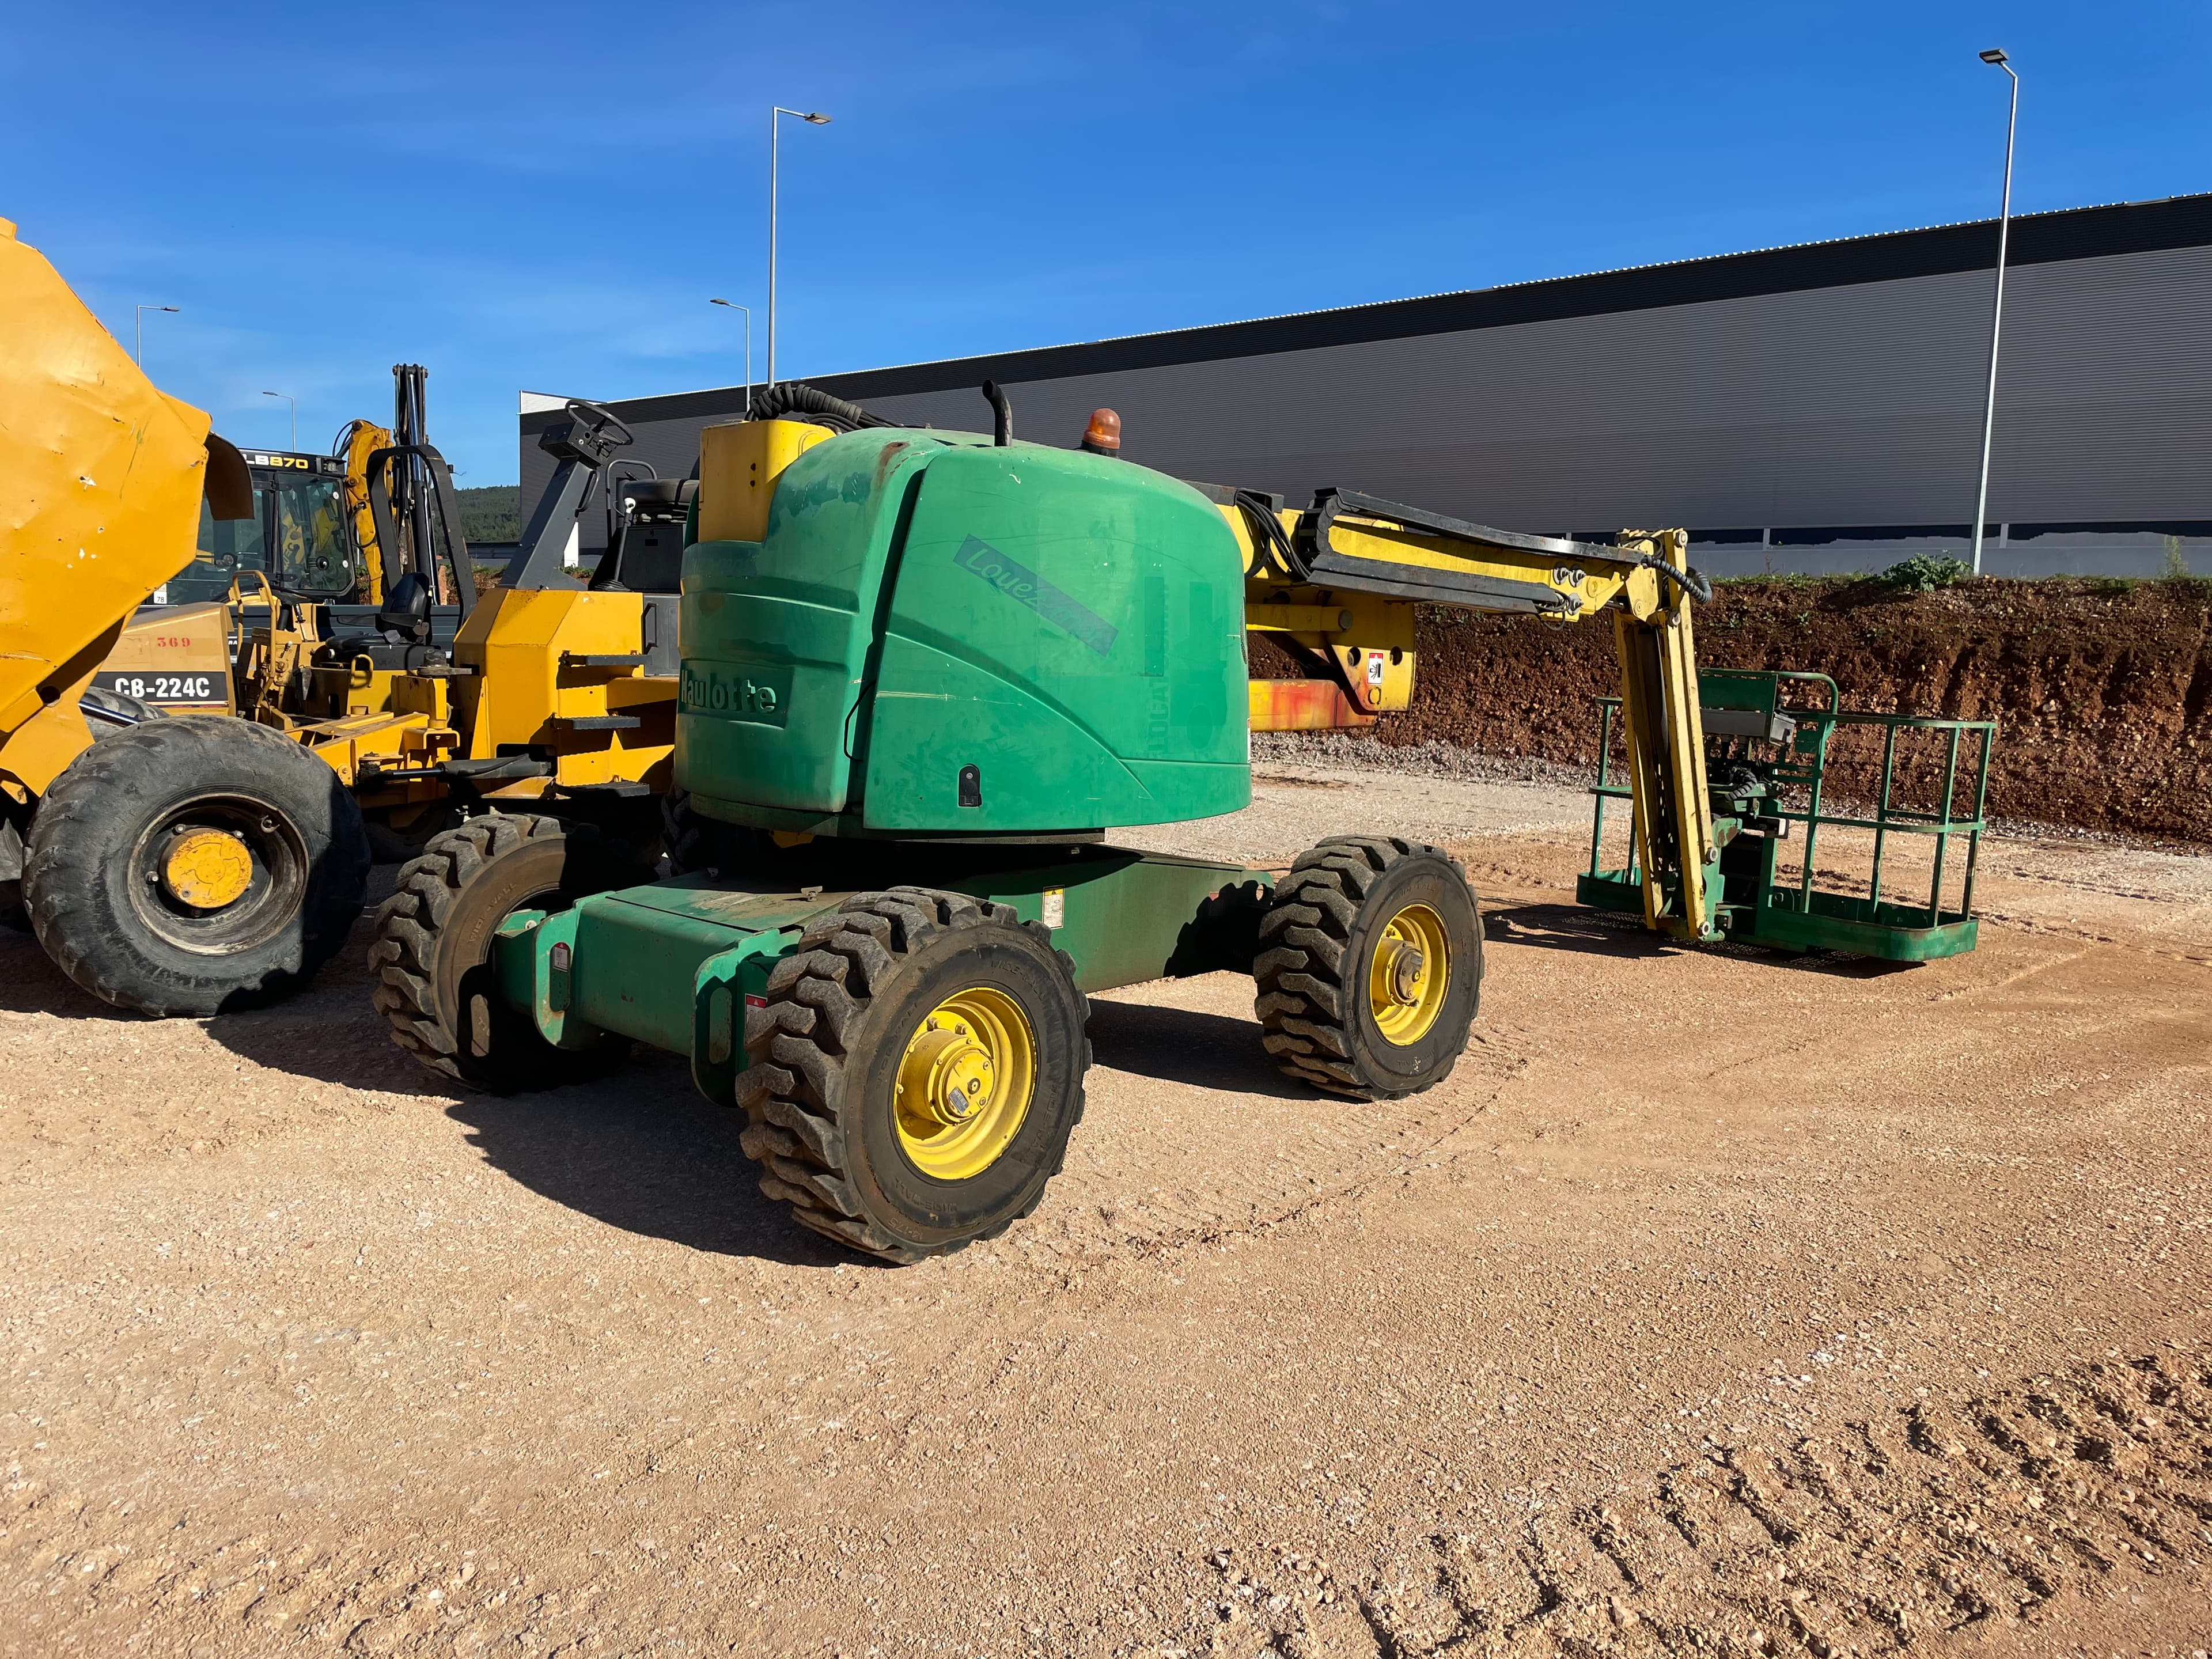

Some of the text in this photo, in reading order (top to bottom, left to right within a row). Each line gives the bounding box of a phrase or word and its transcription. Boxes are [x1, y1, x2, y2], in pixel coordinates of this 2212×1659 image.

[157, 637, 191, 647] 369
[115, 677, 210, 698] CB-224C
[681, 669, 777, 715] Haulotte
